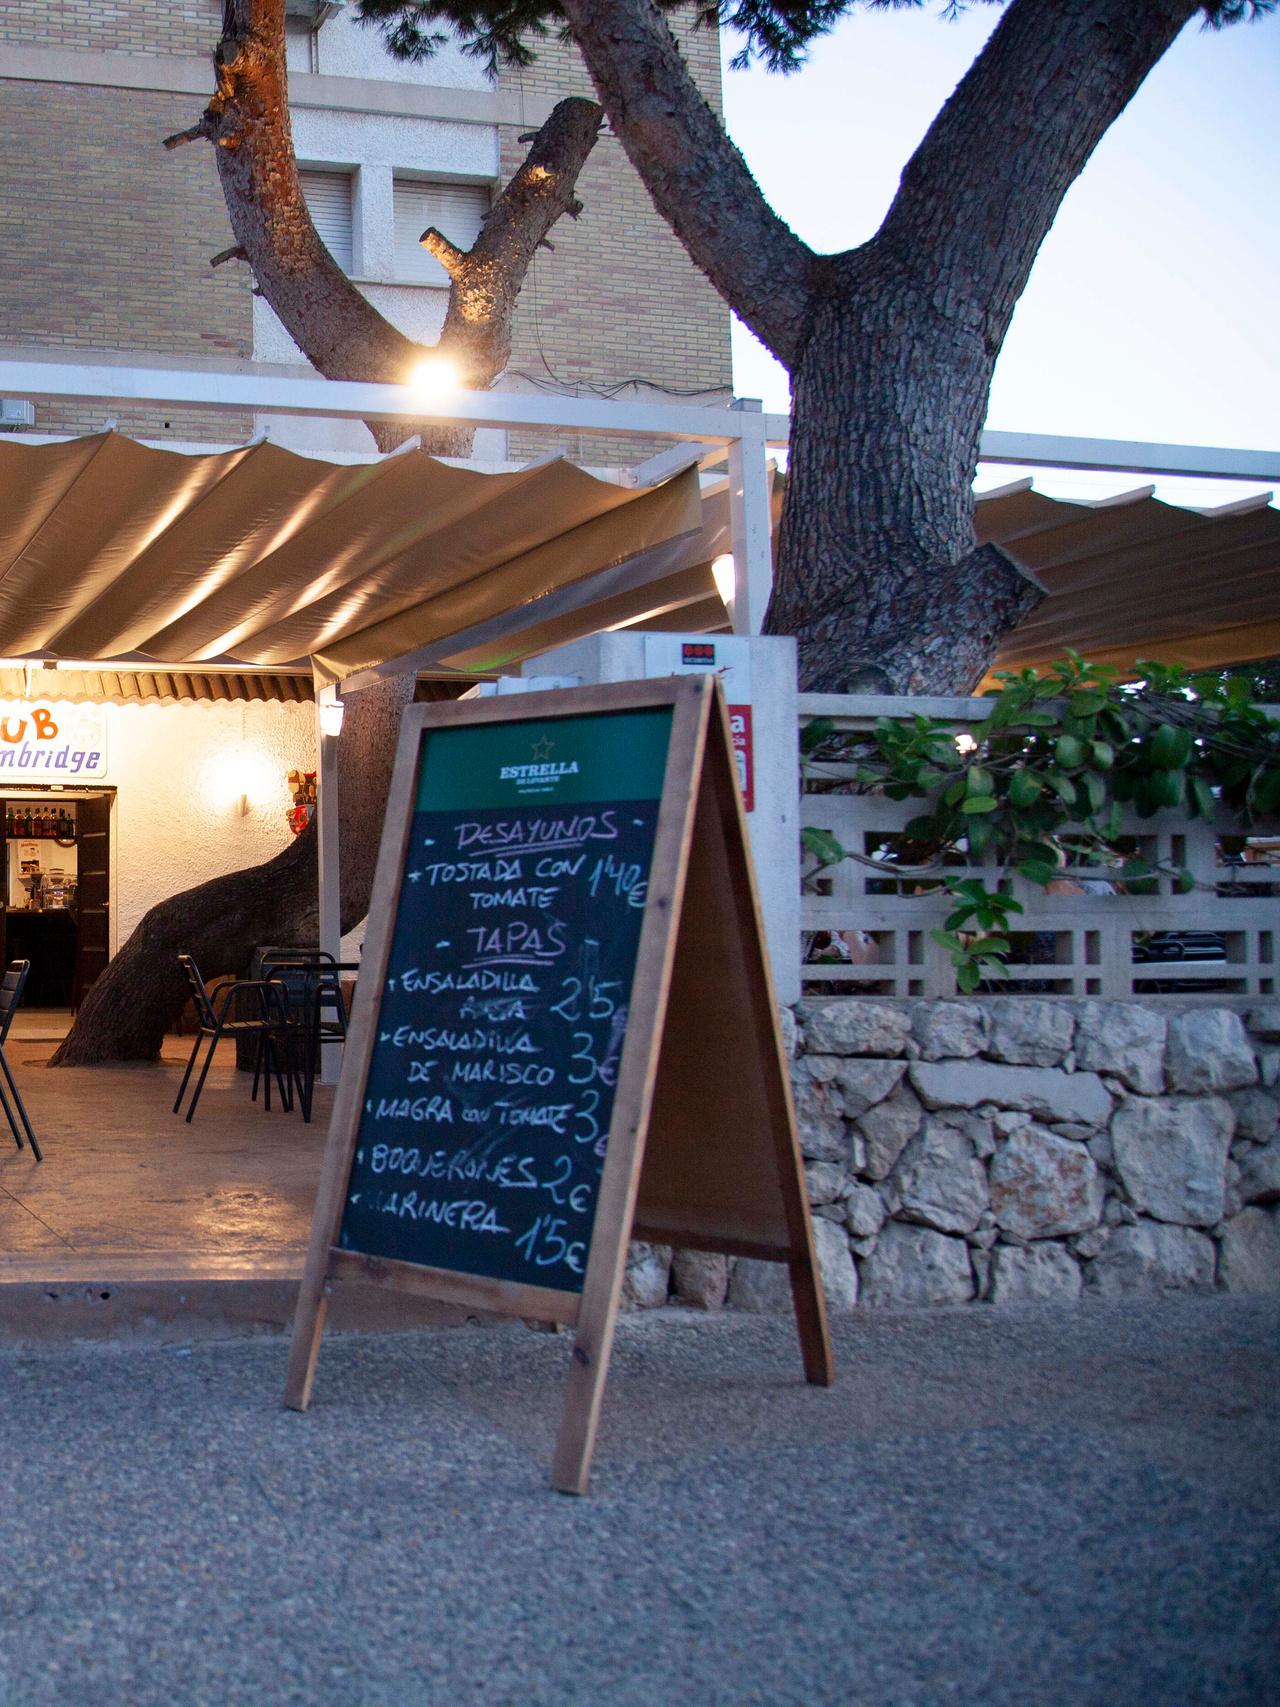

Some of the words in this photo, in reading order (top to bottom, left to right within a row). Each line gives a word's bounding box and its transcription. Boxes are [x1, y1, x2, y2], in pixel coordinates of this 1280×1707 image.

[500, 761, 579, 779] ESTRELLA
[454, 811, 619, 850] DESAYUNOS
[425, 858, 522, 886] TOSTADA
[535, 854, 587, 878] CON
[470, 887, 560, 910] TOMATE
[467, 921, 568, 956] TAPAS
[400, 968, 540, 994] ENSALADILLA
[392, 1025, 542, 1054] ENSALADILLA
[407, 1060, 438, 1083] DE
[451, 1058, 556, 1087] MARISCO
[375, 1095, 454, 1124] MAGRA
[494, 1101, 575, 1134] TOMATE
[369, 1190, 511, 1233] ARINERA
